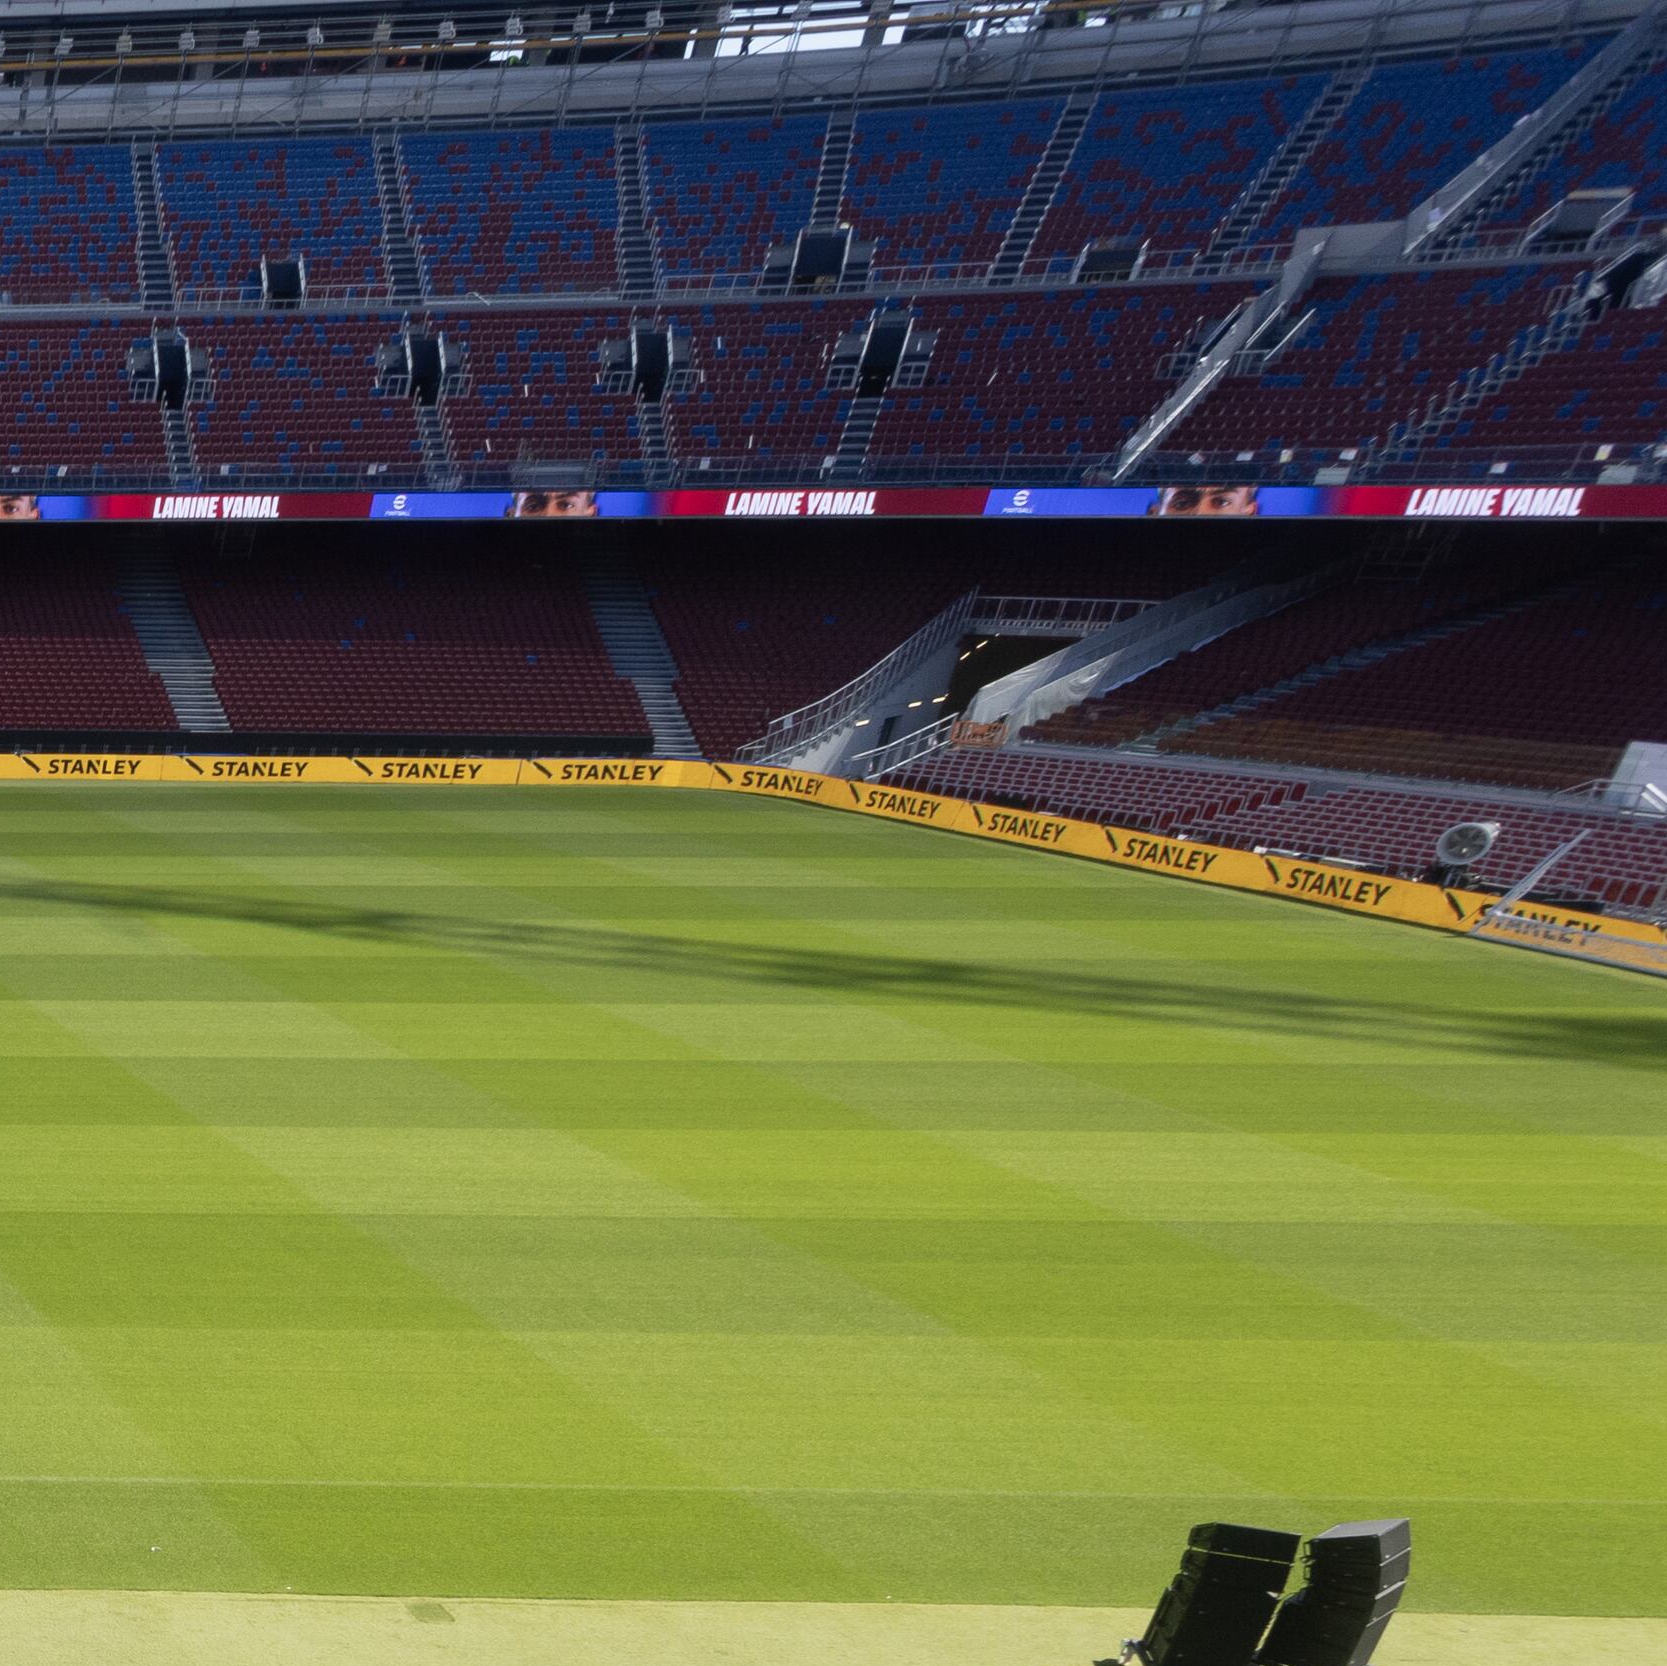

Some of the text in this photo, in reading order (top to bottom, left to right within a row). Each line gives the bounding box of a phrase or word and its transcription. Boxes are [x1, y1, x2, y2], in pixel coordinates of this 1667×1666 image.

[153, 496, 279, 518] LAMINE YAMAL
[725, 491, 876, 516] LAMINE YAMAL
[1405, 487, 1585, 516] LAMINE YAMAL
[47, 759, 142, 775] STANLEY
[211, 761, 308, 777] STANLEY
[380, 763, 483, 780] STANLEY
[560, 763, 664, 781] STANLEY
[740, 770, 824, 797] STANLEY
[865, 790, 941, 819] STANLEY
[987, 812, 1067, 844] STANLEY
[1123, 838, 1219, 873] STANLEY
[1286, 867, 1393, 906] STANLEY
